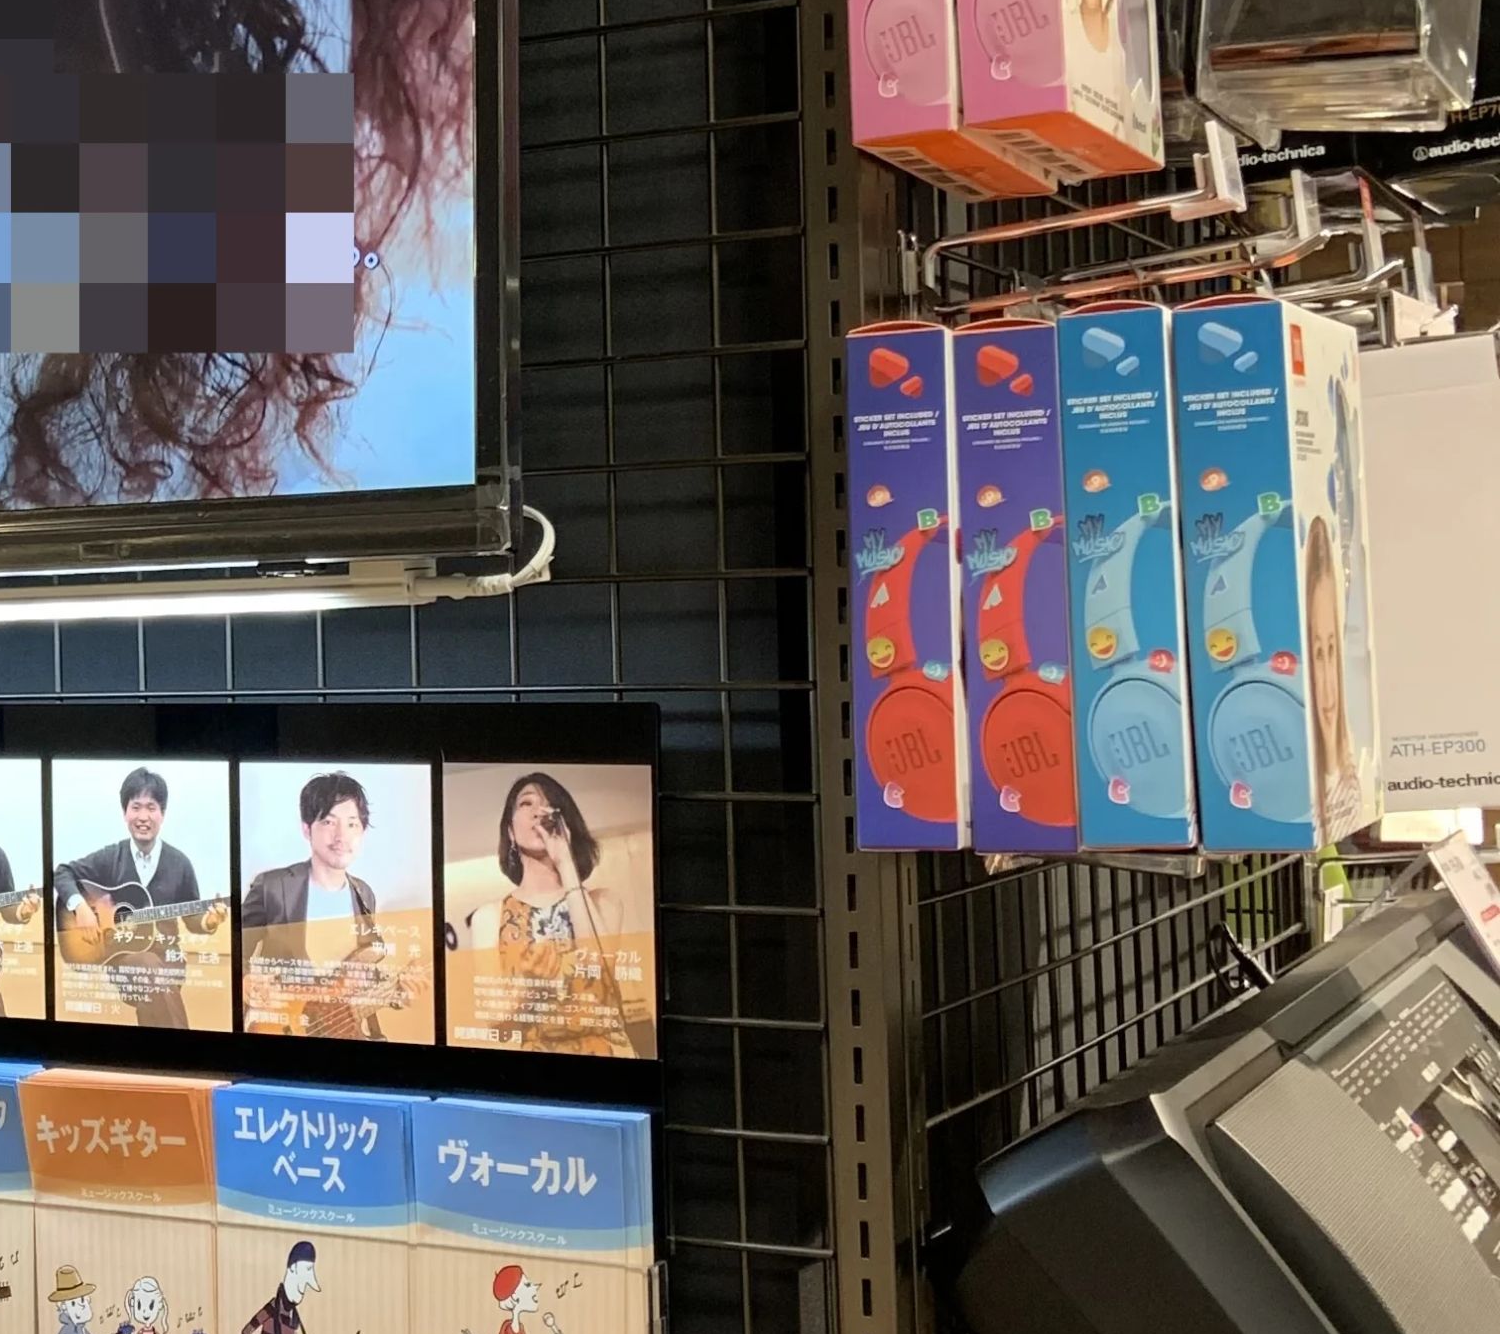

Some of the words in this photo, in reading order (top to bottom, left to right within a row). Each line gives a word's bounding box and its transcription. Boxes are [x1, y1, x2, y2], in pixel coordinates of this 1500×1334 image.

[880, 15, 936, 64] JBL
[1238, 144, 1325, 167] dio-technica
[886, 729, 941, 775] JBL
[1001, 732, 1059, 779] JBL
[1109, 722, 1169, 769] JBL
[1228, 724, 1293, 772] JBL
[1389, 738, 1486, 758] ATH-EP300
[574, 948, 642, 963] ヴォーカル
[35, 1115, 186, 1158] キッズギター
[234, 1106, 378, 1155] エレクトリック
[273, 1152, 346, 1193] ベース
[437, 1139, 598, 1197] ヴォーカル
